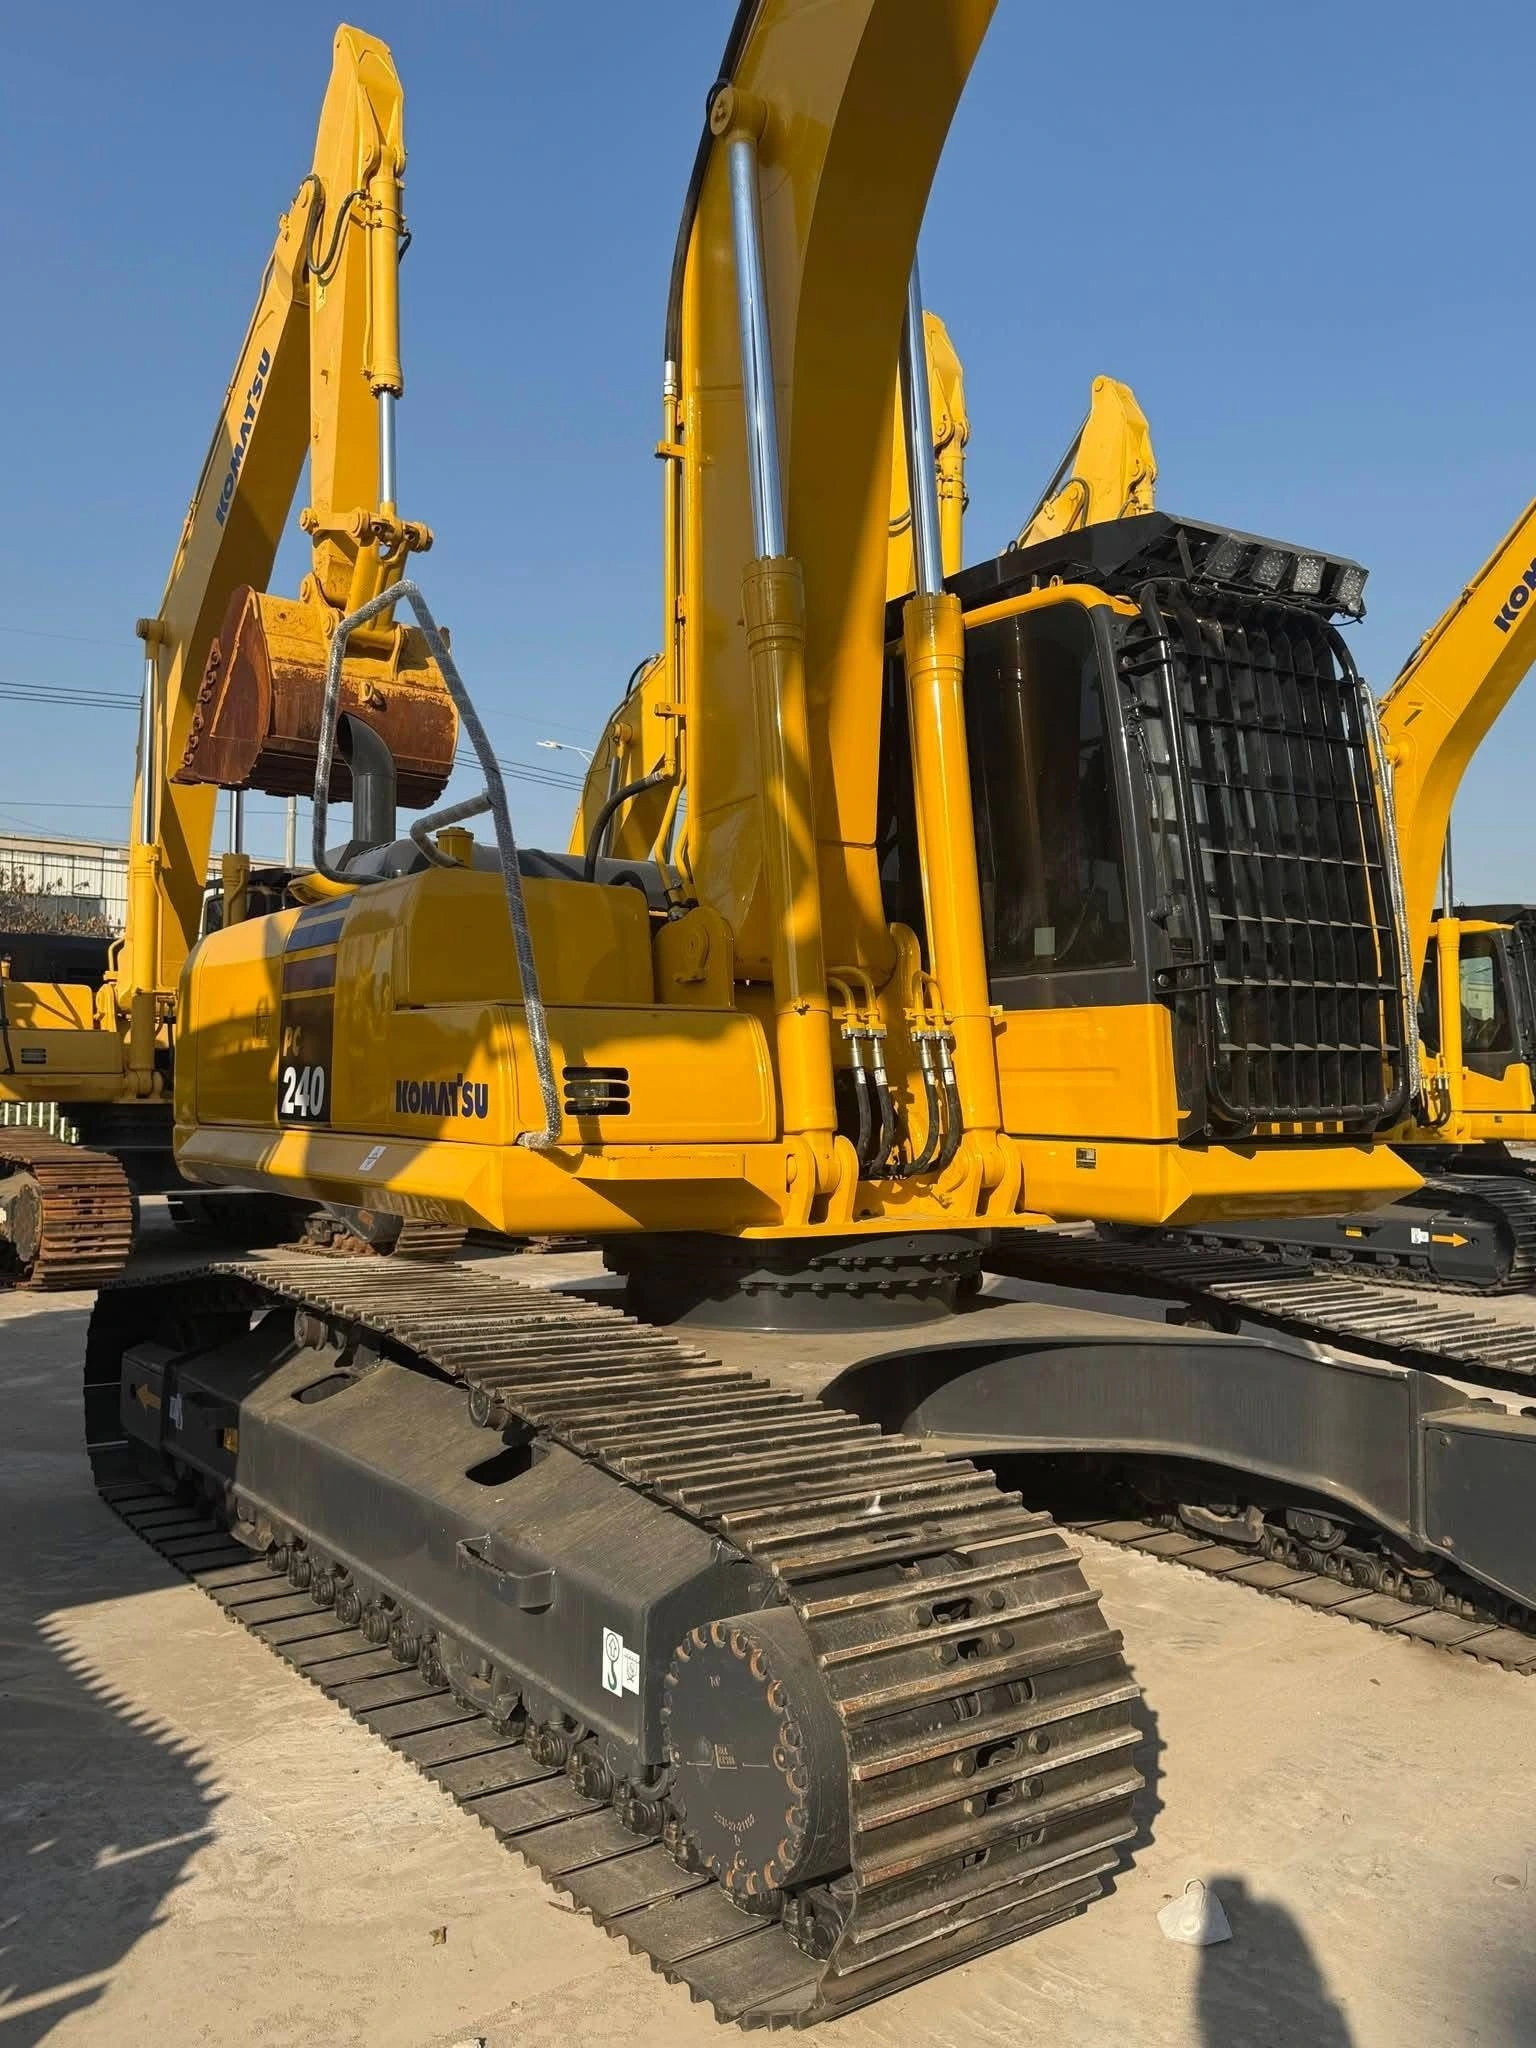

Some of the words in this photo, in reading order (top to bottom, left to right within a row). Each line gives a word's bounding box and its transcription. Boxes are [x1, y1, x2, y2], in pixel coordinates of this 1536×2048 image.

[216, 347, 271, 526] KOMATSU
[283, 1025, 302, 1056] PC
[281, 1066, 325, 1116] 240
[396, 1073, 488, 1119] KOMATSU
